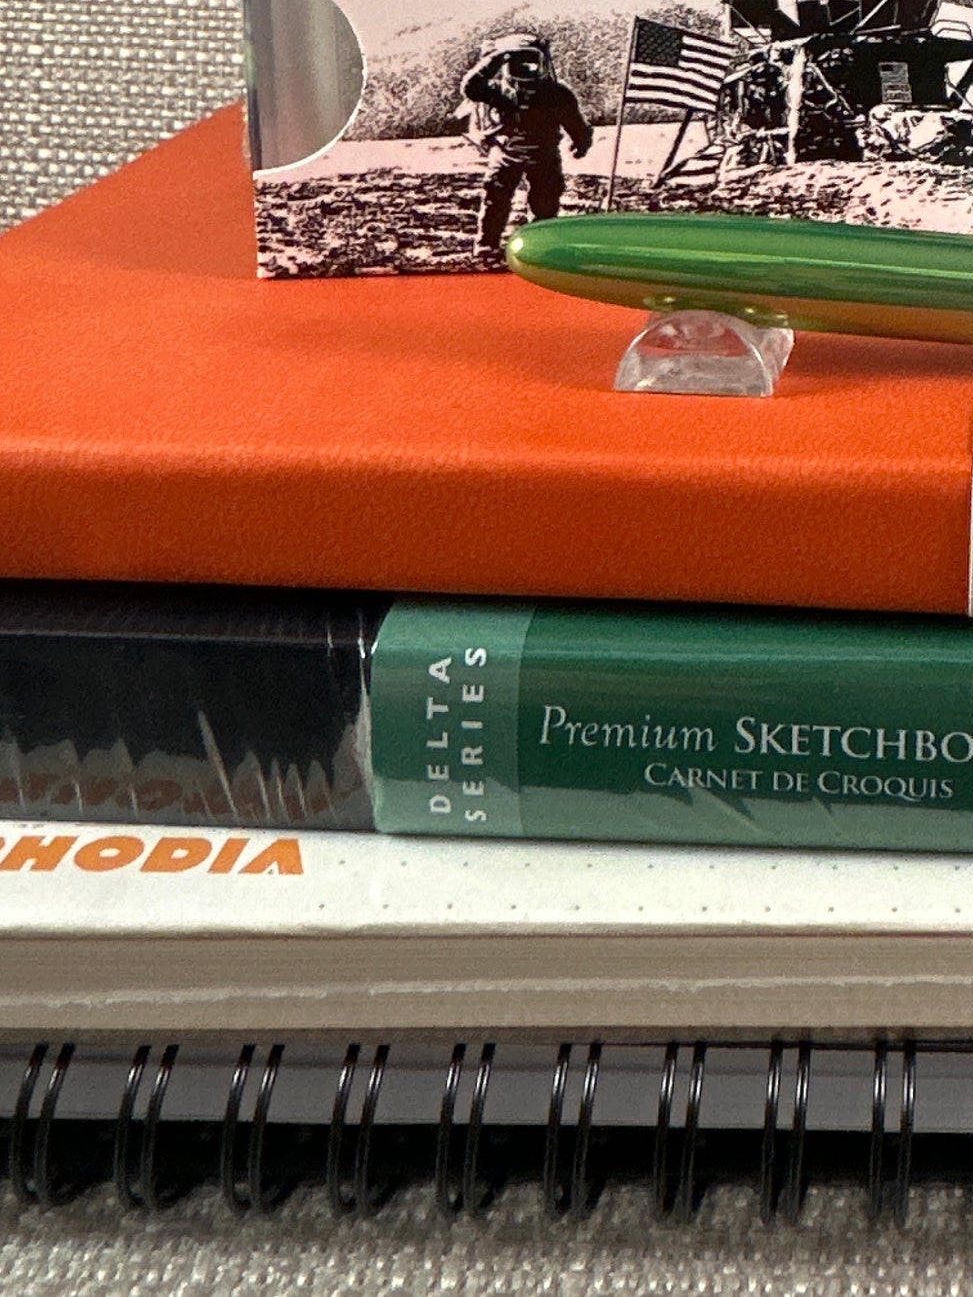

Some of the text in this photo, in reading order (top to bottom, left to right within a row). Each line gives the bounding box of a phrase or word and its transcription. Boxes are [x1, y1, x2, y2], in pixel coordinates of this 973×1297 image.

[426, 656, 453, 814] DELTA
[460, 647, 488, 822] SERIES
[539, 704, 719, 752] Premium
[643, 762, 956, 803] CARNET DE CROQUIS
[0, 835, 305, 876] HODIA
